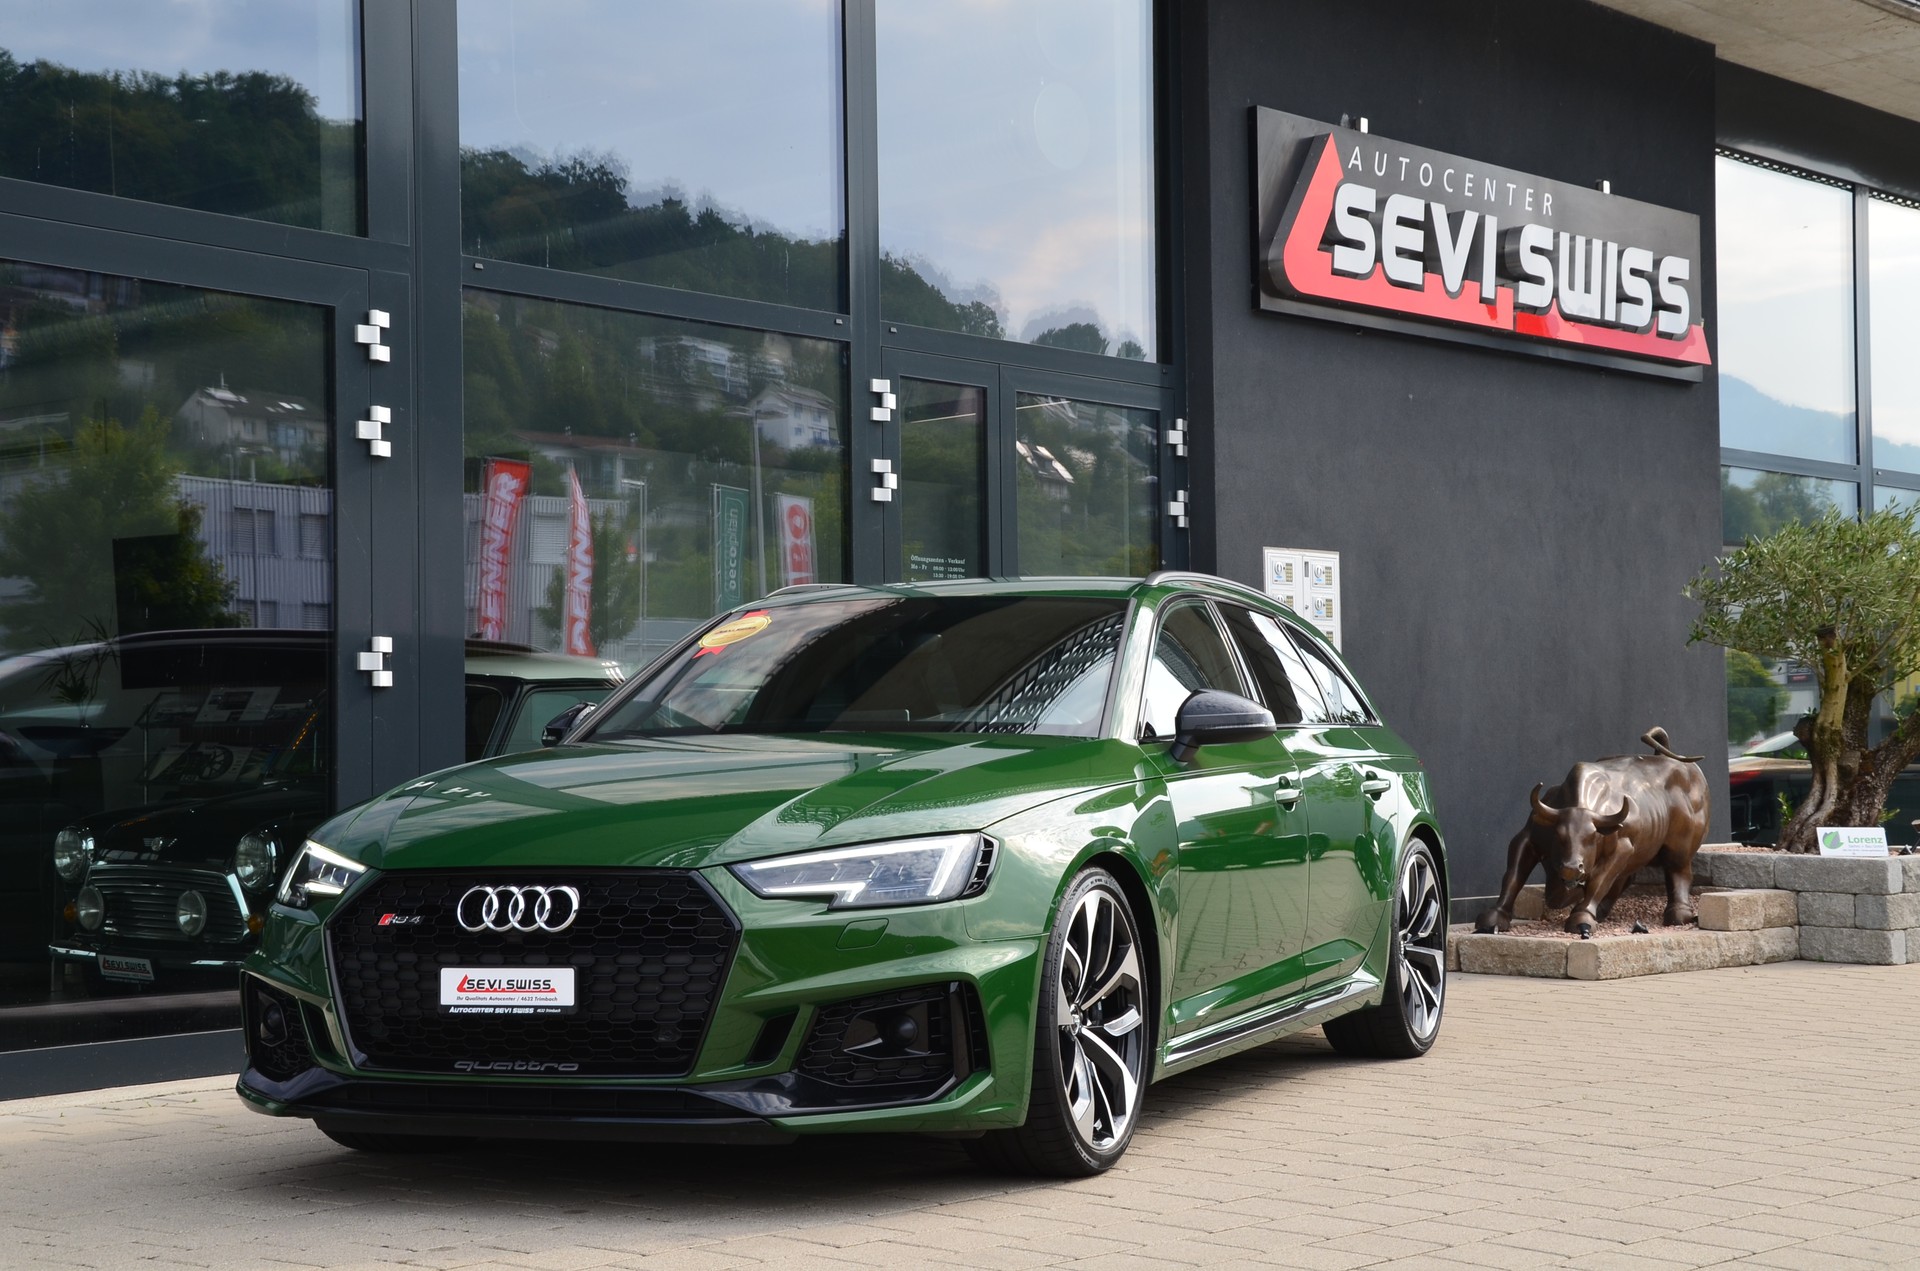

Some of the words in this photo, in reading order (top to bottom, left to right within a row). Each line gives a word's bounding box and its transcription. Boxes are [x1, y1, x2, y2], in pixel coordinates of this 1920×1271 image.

[1348, 145, 1553, 217] AUTOCENTER
[1332, 182, 1498, 300] SEVI
[1518, 223, 1690, 335] SWISS
[1848, 835, 1883, 843] Lorenz
[466, 978, 502, 990] SEVI
[506, 979, 552, 990] SWISS
[454, 1060, 579, 1072] quattro
